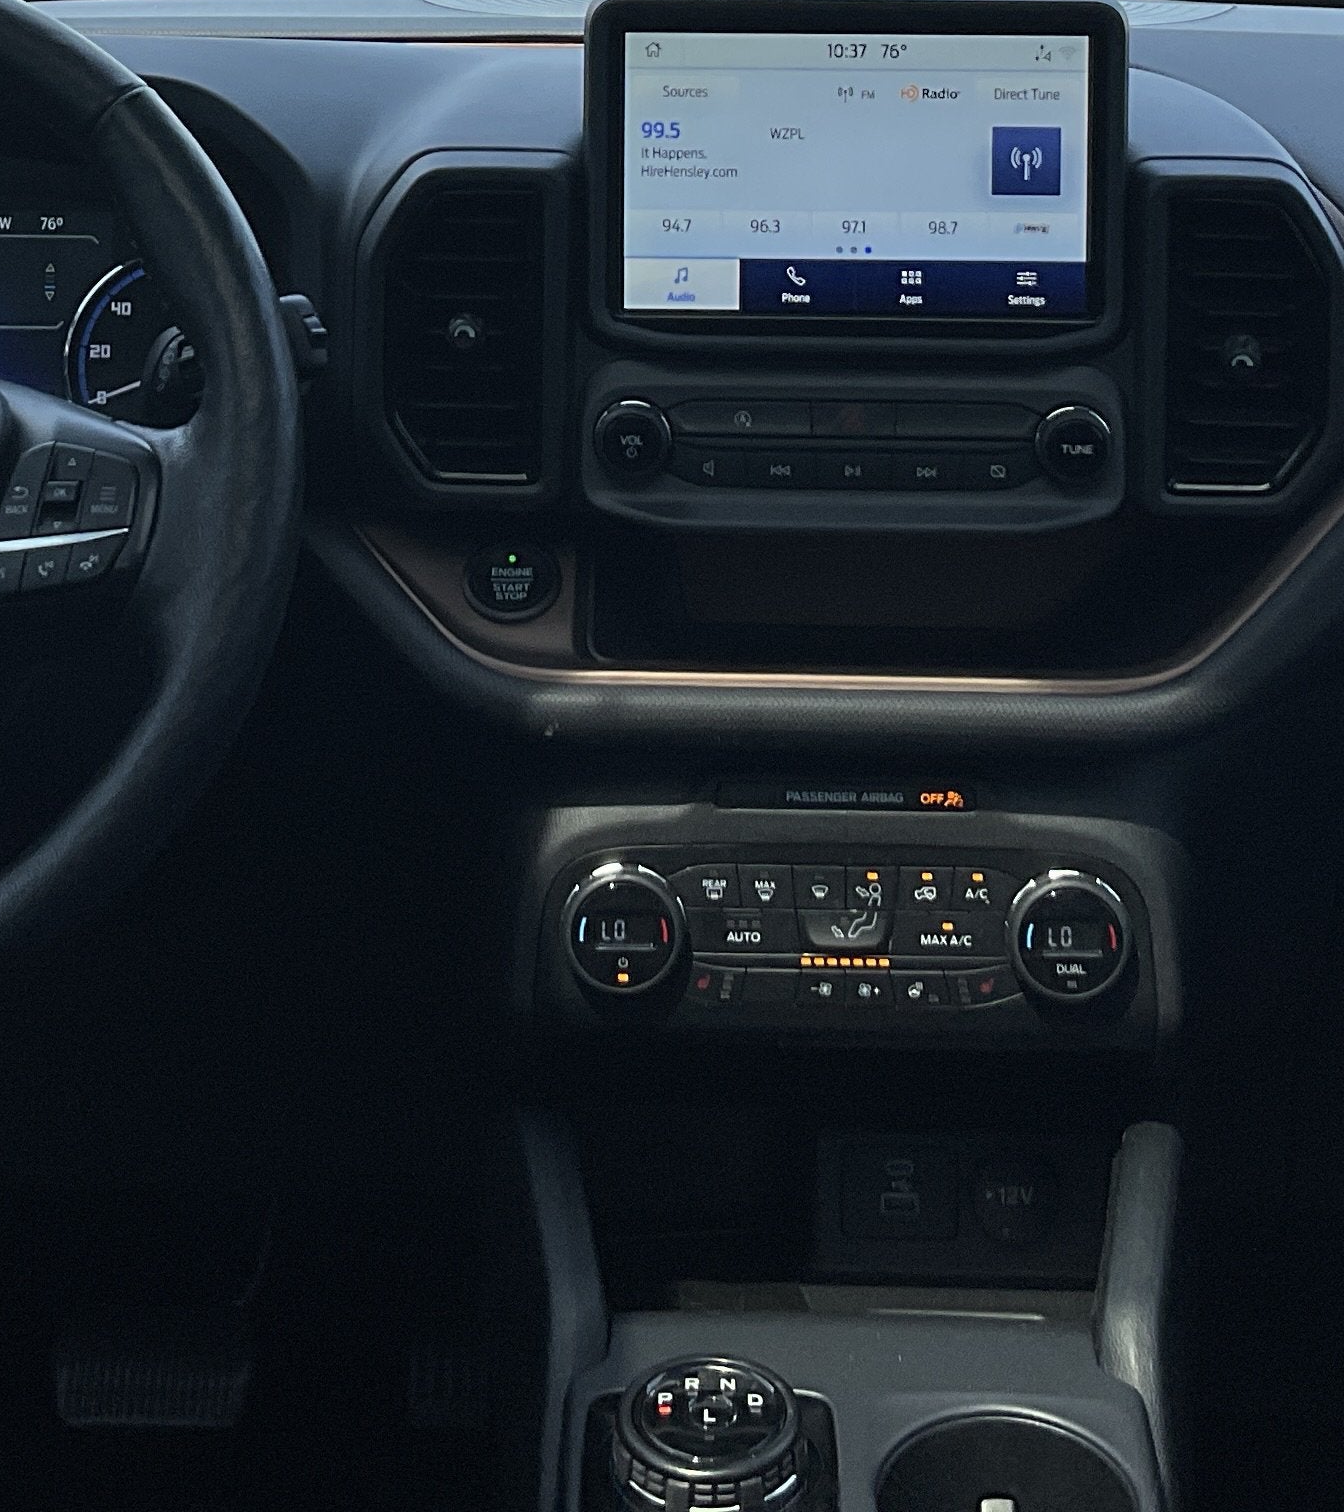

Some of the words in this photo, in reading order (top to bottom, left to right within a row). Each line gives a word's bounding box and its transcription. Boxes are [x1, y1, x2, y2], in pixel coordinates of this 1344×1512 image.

[827, 43, 867, 59] 10:37
[880, 44, 907, 59] 76°
[662, 85, 708, 98] Sources
[861, 90, 875, 99] FM
[922, 88, 959, 100] Radio
[994, 88, 1028, 101] Direct
[1031, 88, 1060, 101] Tune
[641, 121, 681, 139] 99.5
[770, 127, 805, 140] WZPL
[641, 147, 649, 159] It
[641, 165, 738, 179] HireHensley.com
[662, 218, 692, 233] 94.7
[750, 219, 781, 234] 96.3
[842, 220, 867, 234] 97.1
[928, 220, 958, 235] 98.7
[667, 292, 696, 303] Audio
[782, 292, 811, 304] Phone
[899, 294, 923, 306] Apps
[1007, 294, 1046, 307] Settings
[111, 301, 132, 316] 40
[89, 343, 111, 359] 20
[620, 434, 643, 445] VOL
[1061, 444, 1094, 455] TUNE
[491, 567, 533, 577] ENGINE
[492, 583, 531, 592] START
[495, 591, 528, 601] STOP
[786, 790, 856, 803] PASSENGER
[861, 791, 904, 804] AIRBAG
[920, 792, 944, 805] OFF
[702, 879, 727, 888] REAR
[755, 880, 776, 889] MAX
[965, 887, 988, 900] A/C
[601, 919, 626, 943] LO
[726, 931, 761, 943] AUTO
[1048, 925, 1073, 948] LO
[920, 934, 948, 946] MAX
[950, 934, 972, 946] A/C
[1056, 963, 1087, 975] DUAL
[684, 1377, 699, 1390] R
[720, 1377, 736, 1391] N
[657, 1392, 673, 1405] P
[747, 1393, 764, 1406] D
[703, 1408, 717, 1423] L
